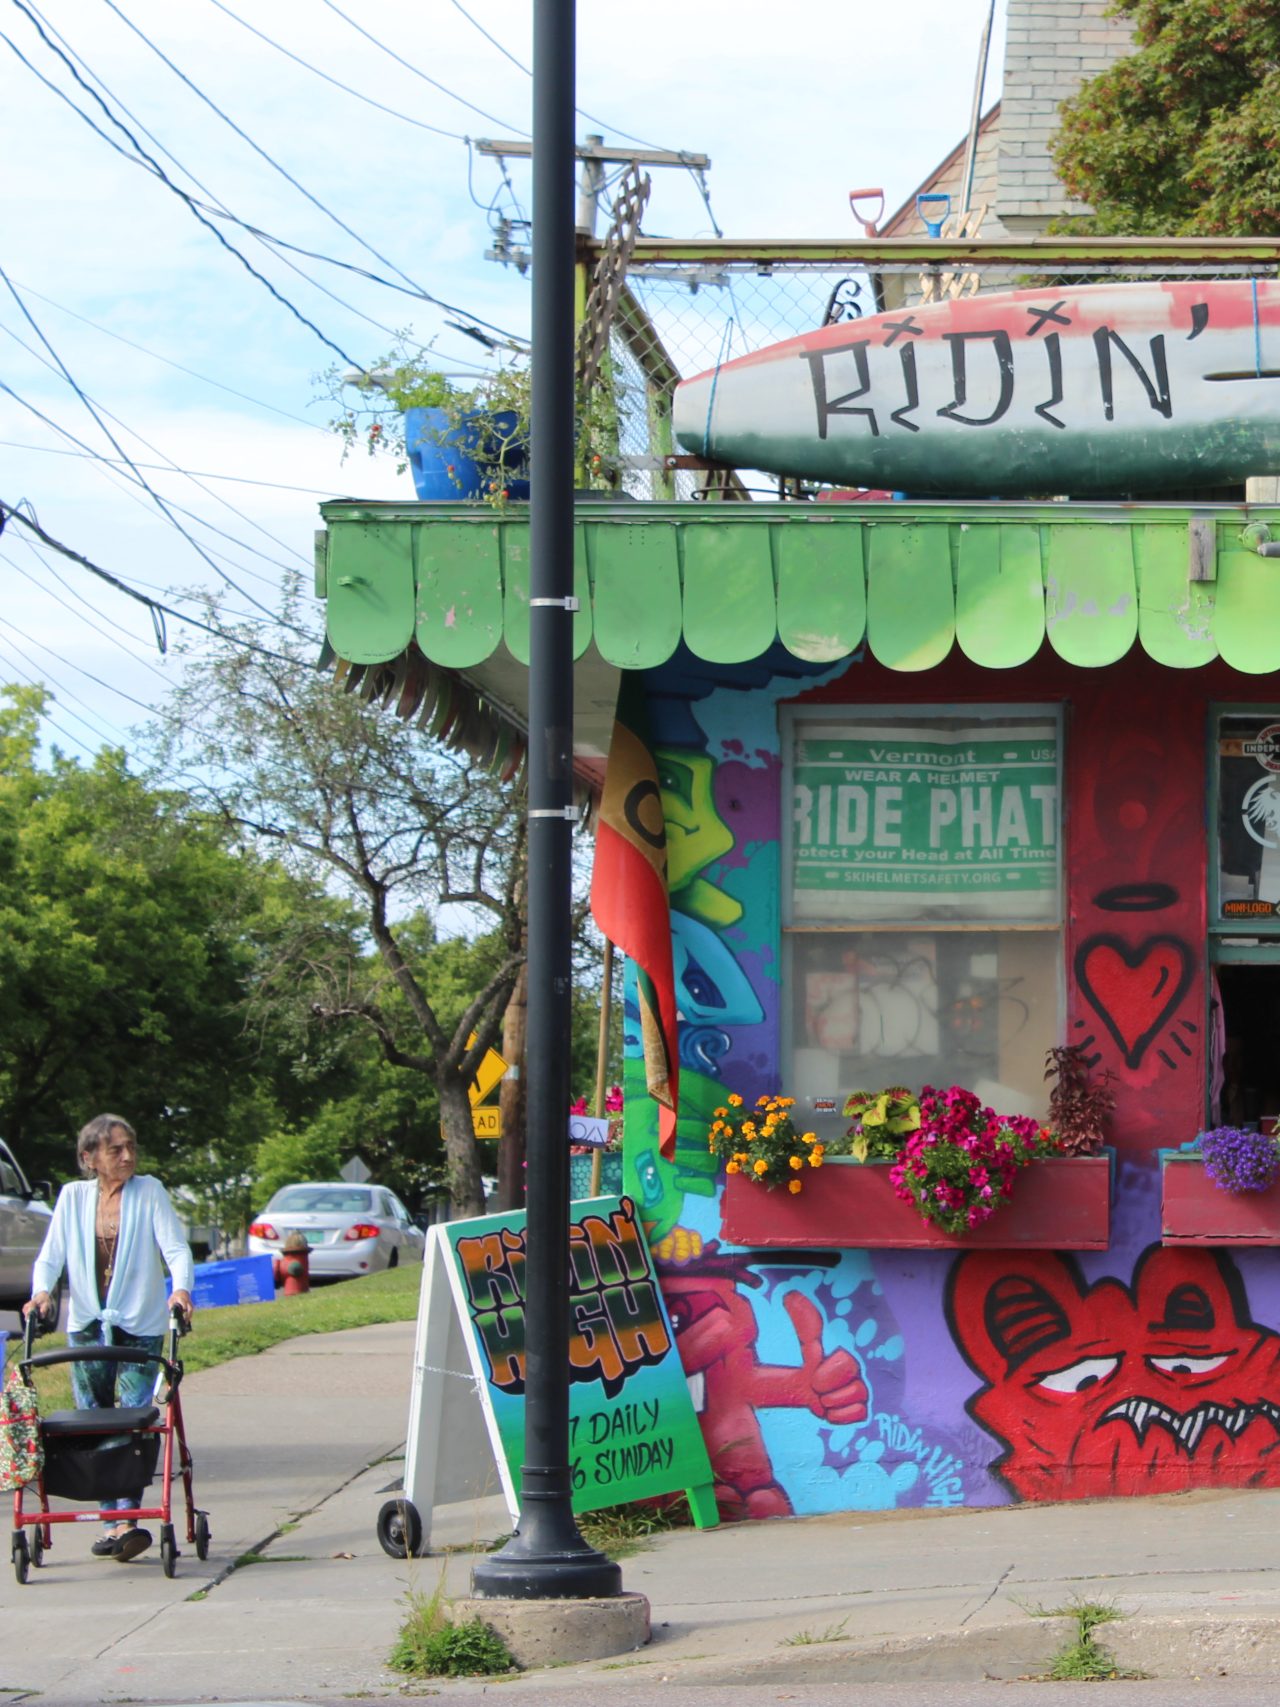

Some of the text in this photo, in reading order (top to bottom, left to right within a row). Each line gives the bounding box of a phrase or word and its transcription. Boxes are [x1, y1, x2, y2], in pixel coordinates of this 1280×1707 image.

[869, 748, 976, 766] Vermont
[845, 770, 1001, 785] WEAR A HELMET
[793, 784, 1057, 849] RIDE PHAT
[854, 848, 896, 862] your
[902, 848, 948, 862] Head
[954, 848, 973, 861] at
[979, 847, 1004, 860] All
[844, 870, 1002, 886] SKIHELMETSAFETY.ORG
[474, 1281, 672, 1387] HGH
[594, 1437, 674, 1485] SUNDAY
